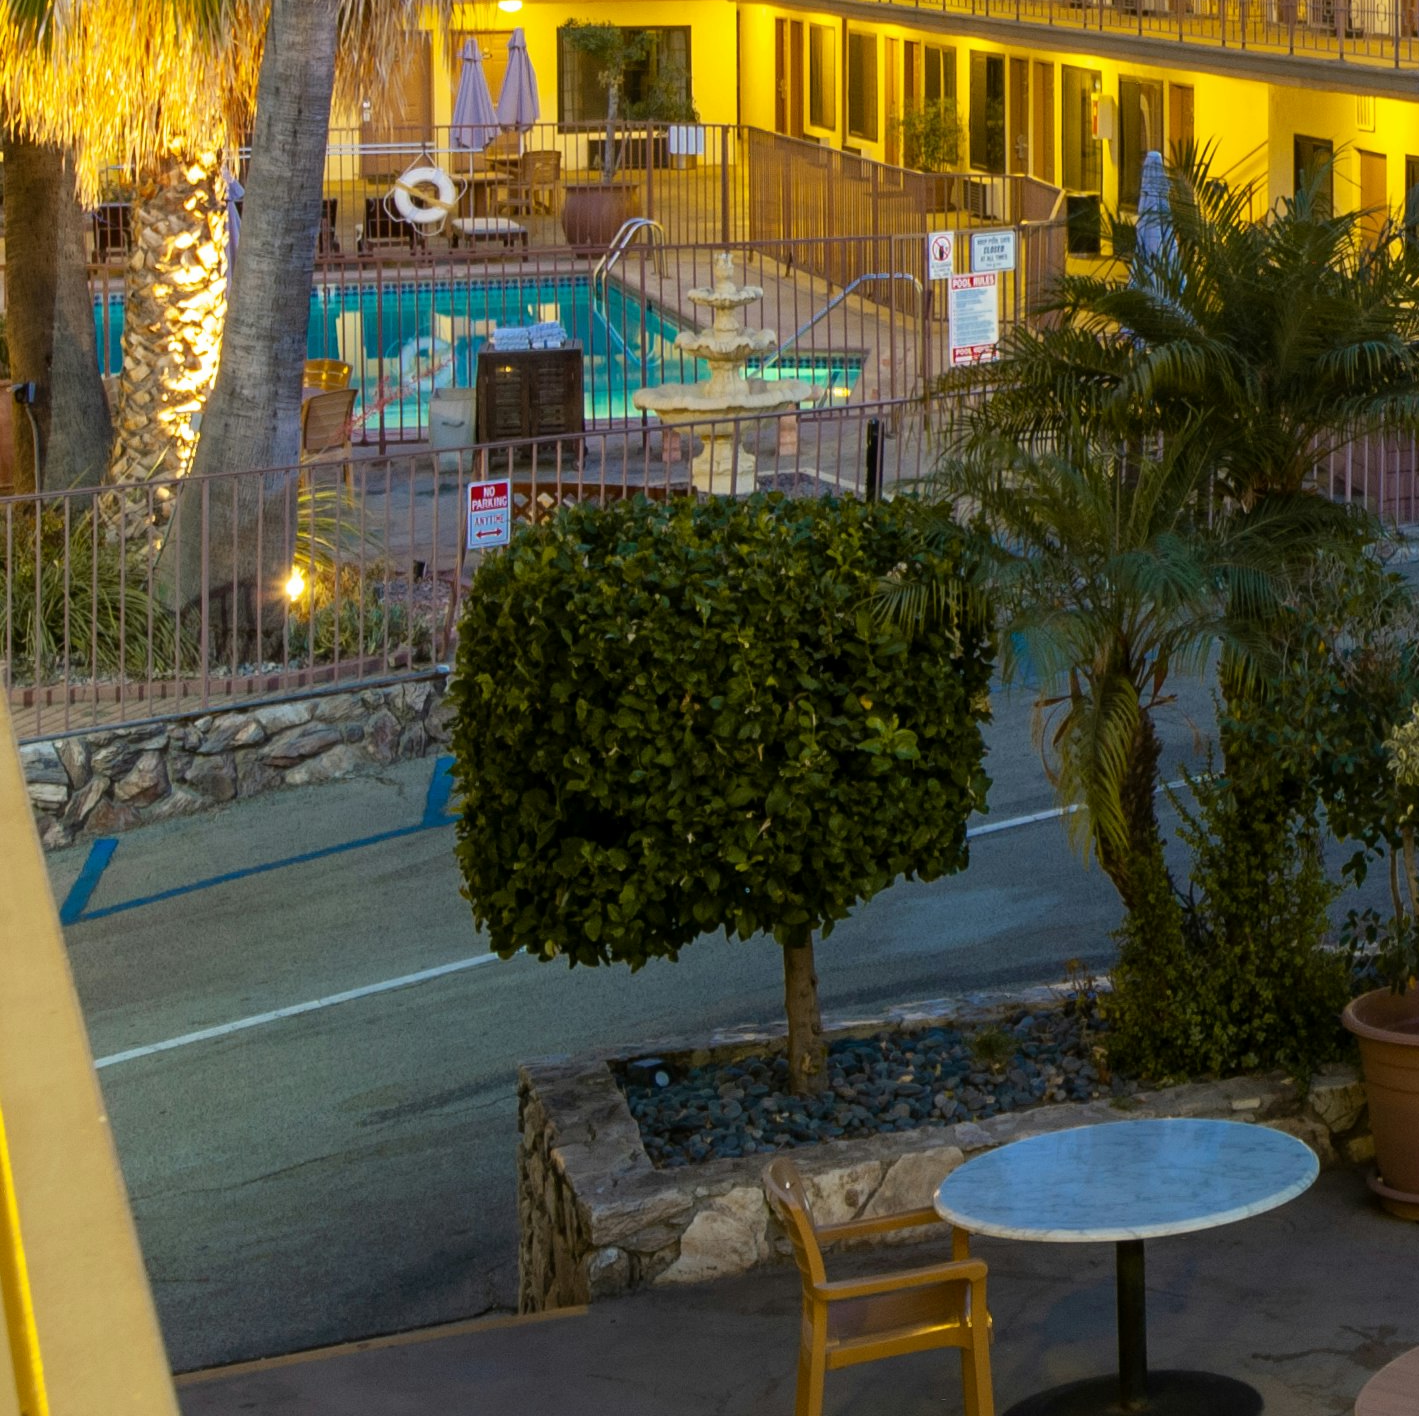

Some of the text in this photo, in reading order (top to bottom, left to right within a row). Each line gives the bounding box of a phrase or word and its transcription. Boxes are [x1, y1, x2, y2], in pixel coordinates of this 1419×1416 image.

[983, 245, 1005, 254] CLOSED
[952, 274, 995, 289] POOL RULES
[483, 486, 495, 498] NO
[471, 496, 508, 511] PARKING
[474, 514, 504, 527] ANYTIME
